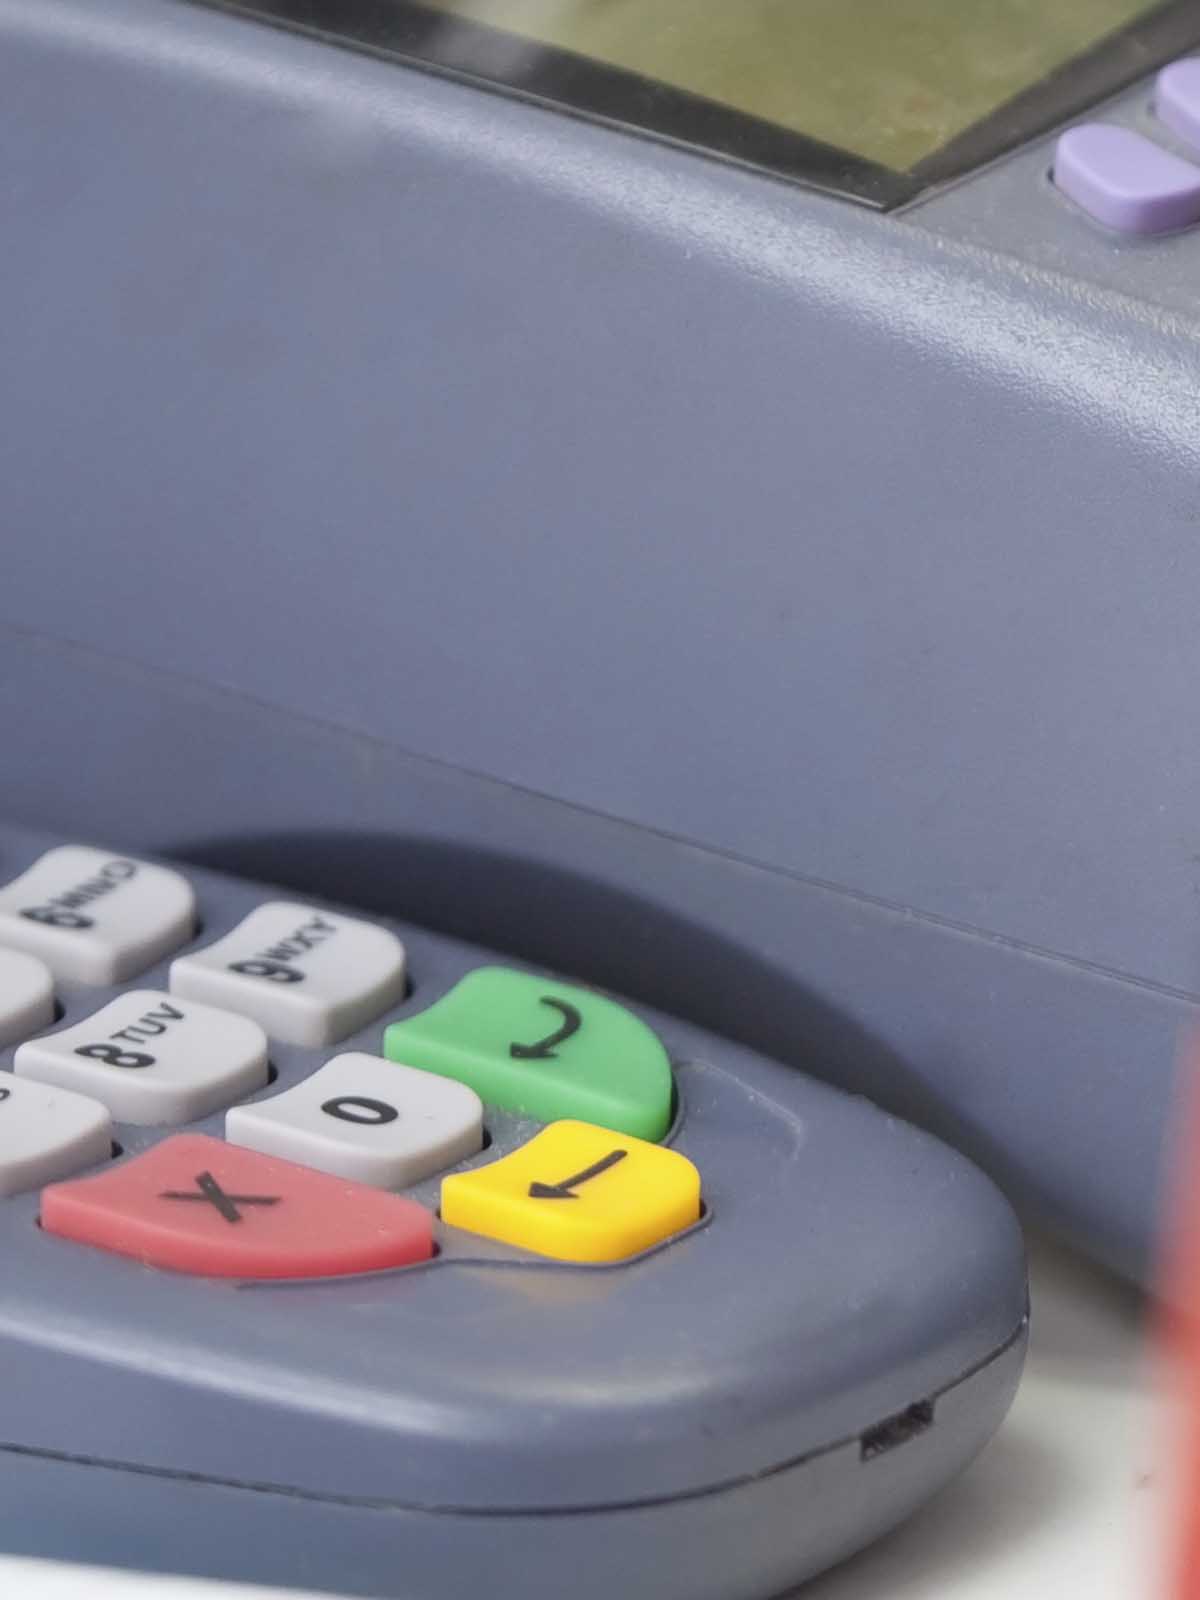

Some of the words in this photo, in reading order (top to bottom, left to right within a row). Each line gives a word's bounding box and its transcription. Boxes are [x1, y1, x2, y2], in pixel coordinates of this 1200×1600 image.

[19, 905, 95, 930] 6
[252, 915, 338, 961] WXY
[227, 960, 306, 983] 9
[108, 1001, 185, 1044] TUV
[73, 1044, 156, 1068] 8
[321, 1096, 399, 1125] 0
